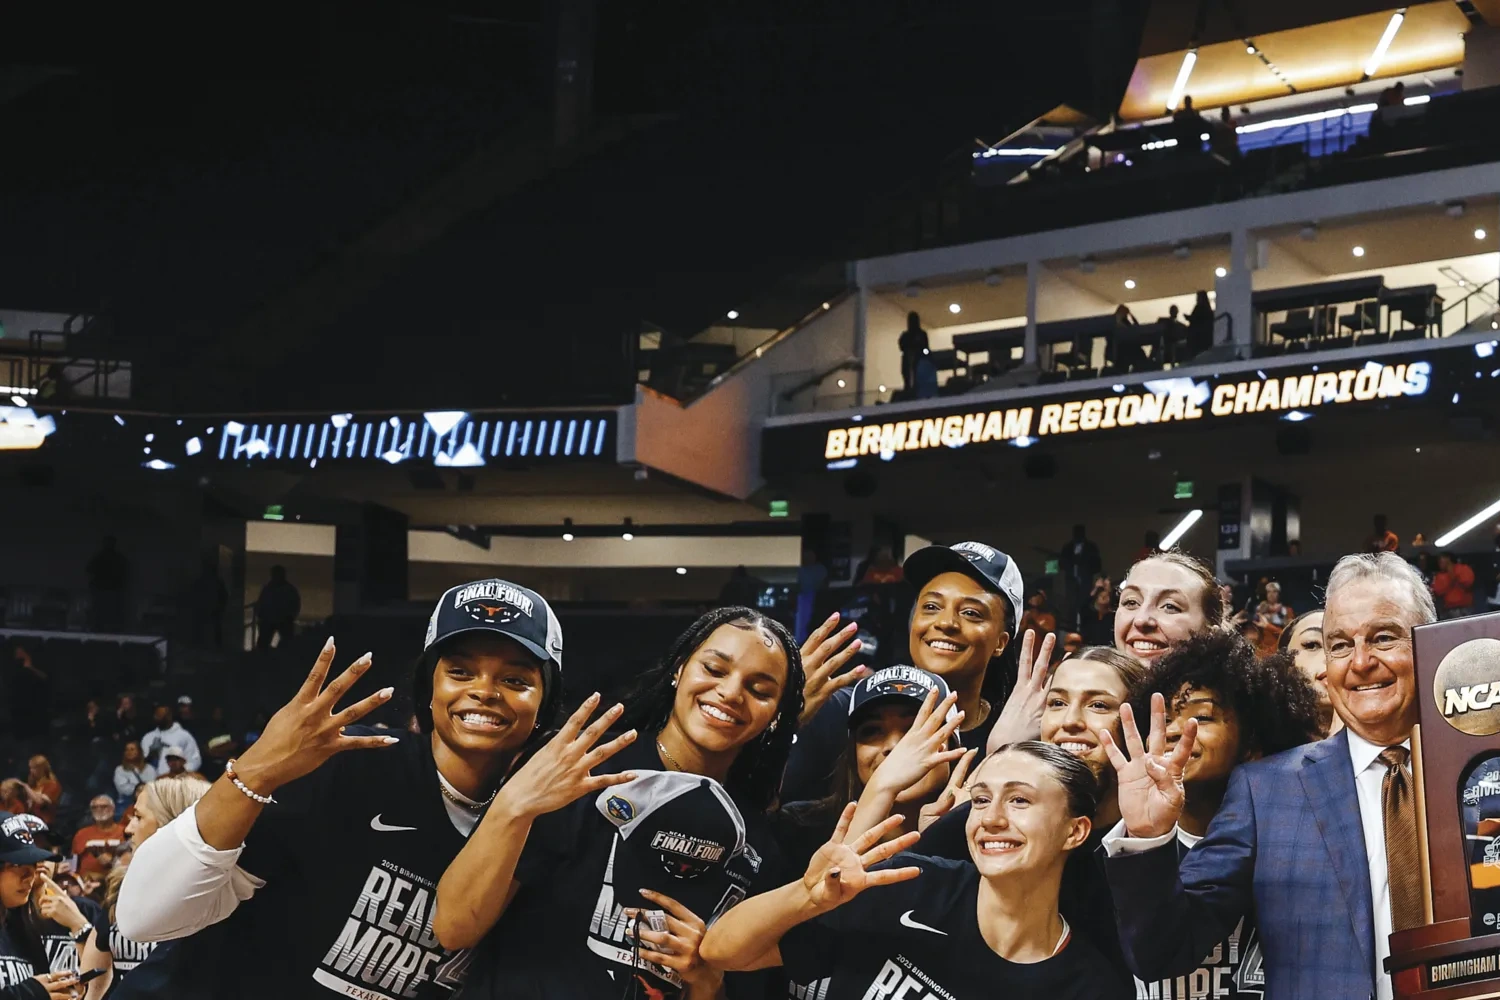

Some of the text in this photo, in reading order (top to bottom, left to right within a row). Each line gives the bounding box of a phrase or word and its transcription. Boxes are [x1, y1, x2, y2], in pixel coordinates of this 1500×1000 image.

[825, 362, 1431, 459] BIRMINGHAM REGIONAL CHAMPIONS
[455, 585, 532, 616] FINAL FOUR
[866, 668, 898, 692] FINAL
[902, 668, 934, 690] FOUR
[652, 832, 693, 854] FINAL
[694, 844, 723, 861] FOUR
[690, 837, 719, 847] BASKETBALL
[381, 860, 398, 872] 2025
[109, 931, 158, 960] MOR
[322, 917, 441, 998] MORE
[896, 953, 913, 970] 2025
[1431, 957, 1496, 983] BIRMINGHAM
[345, 985, 374, 1000] TEXAS
